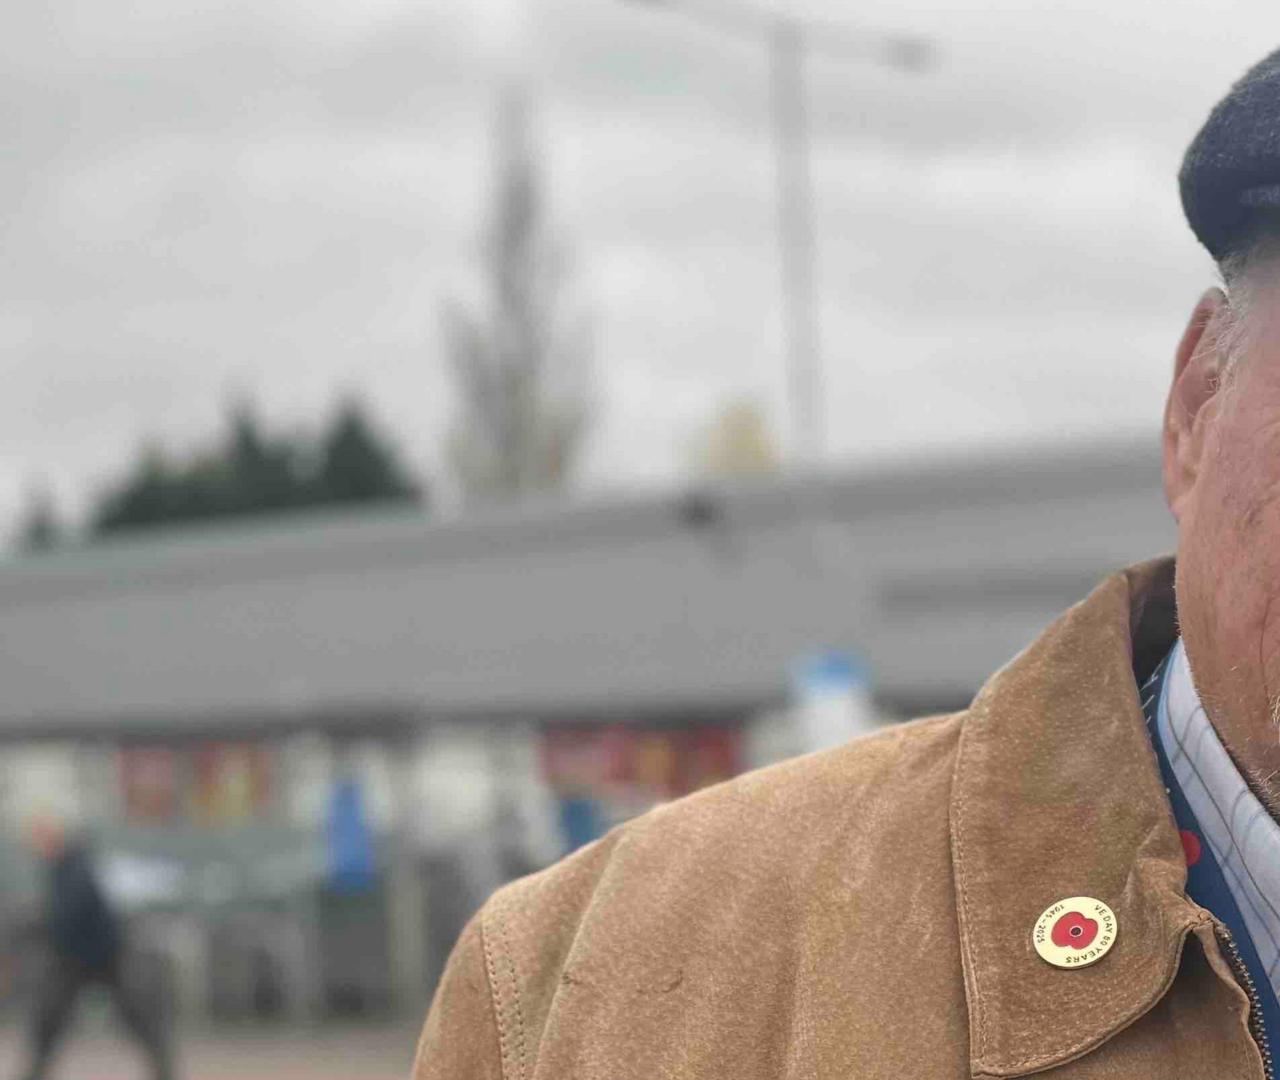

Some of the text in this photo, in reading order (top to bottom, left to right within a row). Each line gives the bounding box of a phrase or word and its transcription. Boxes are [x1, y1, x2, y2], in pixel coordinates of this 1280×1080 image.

[1094, 904, 1107, 916] VE
[1102, 915, 1113, 934] DAY
[1065, 946, 1103, 964] YEARS
